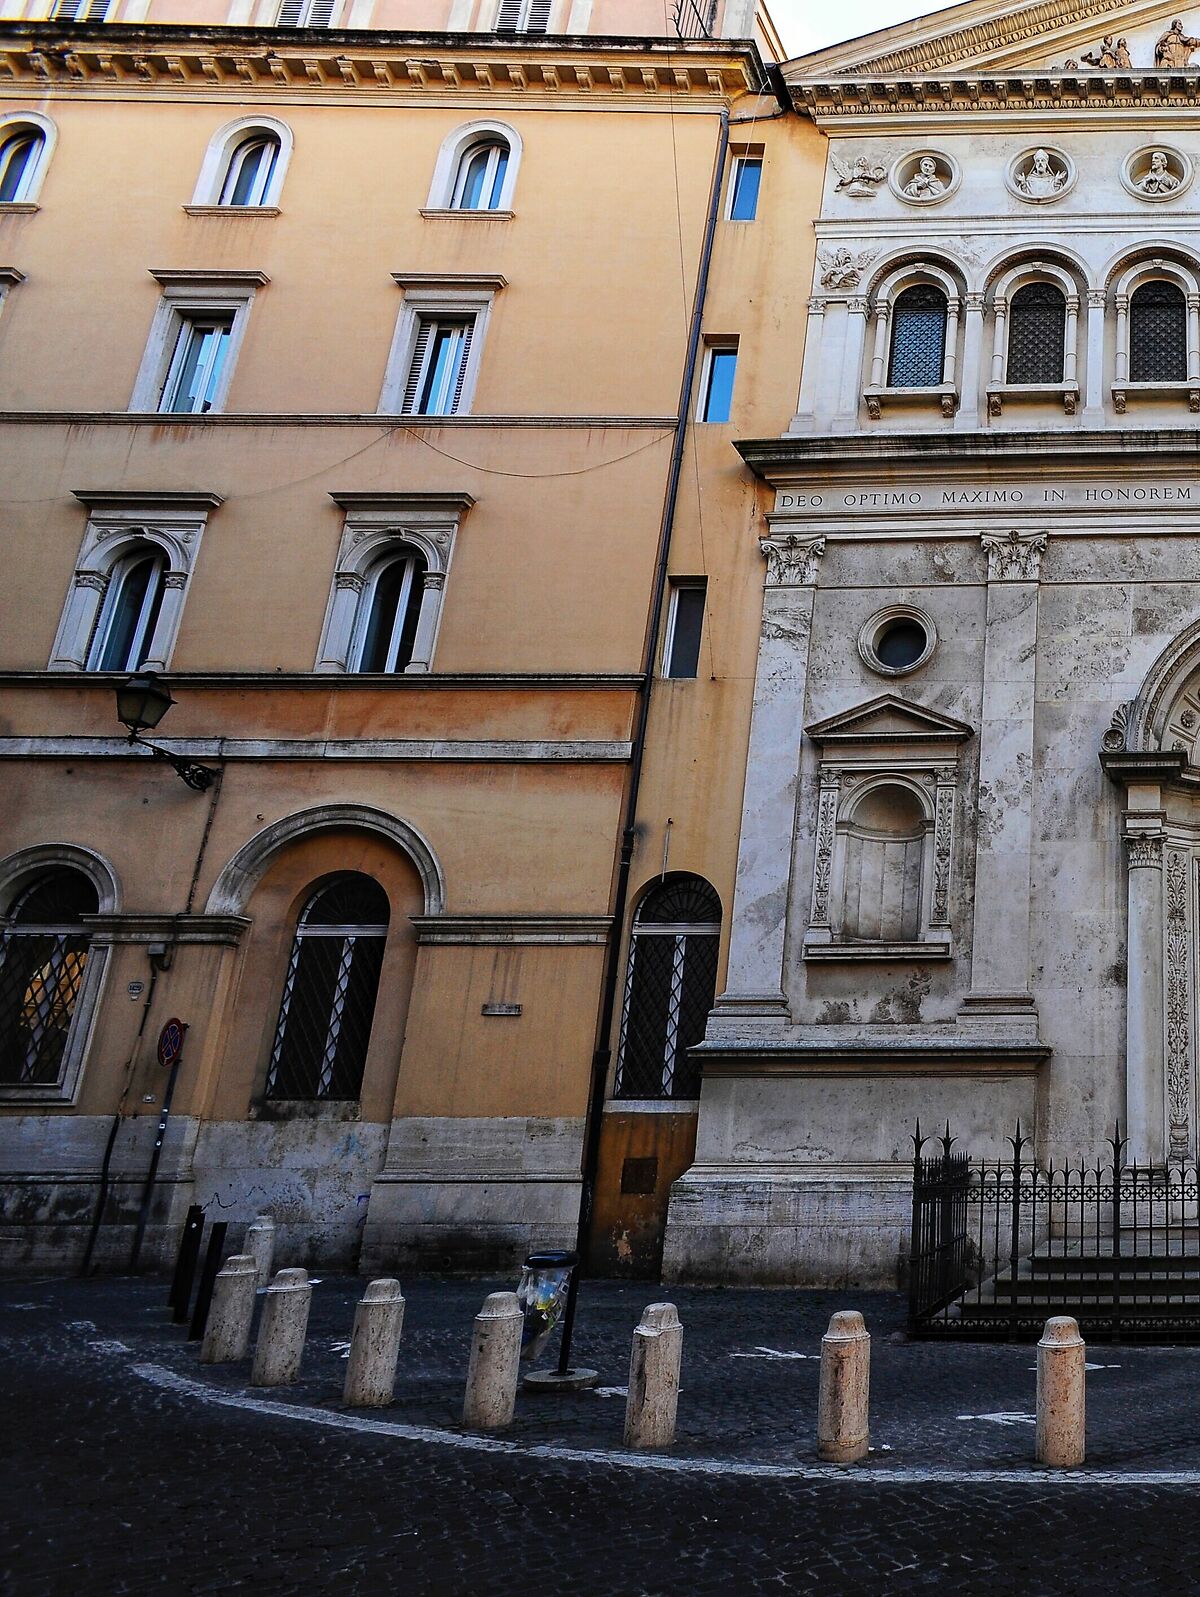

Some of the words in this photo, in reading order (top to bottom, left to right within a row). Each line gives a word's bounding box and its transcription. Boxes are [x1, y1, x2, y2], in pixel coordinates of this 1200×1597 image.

[781, 495, 823, 507] DEO
[844, 492, 922, 505] OPTIMO
[941, 490, 1024, 503] MAXIMO
[1044, 489, 1066, 502] IN
[1085, 487, 1192, 500] HONOREM
